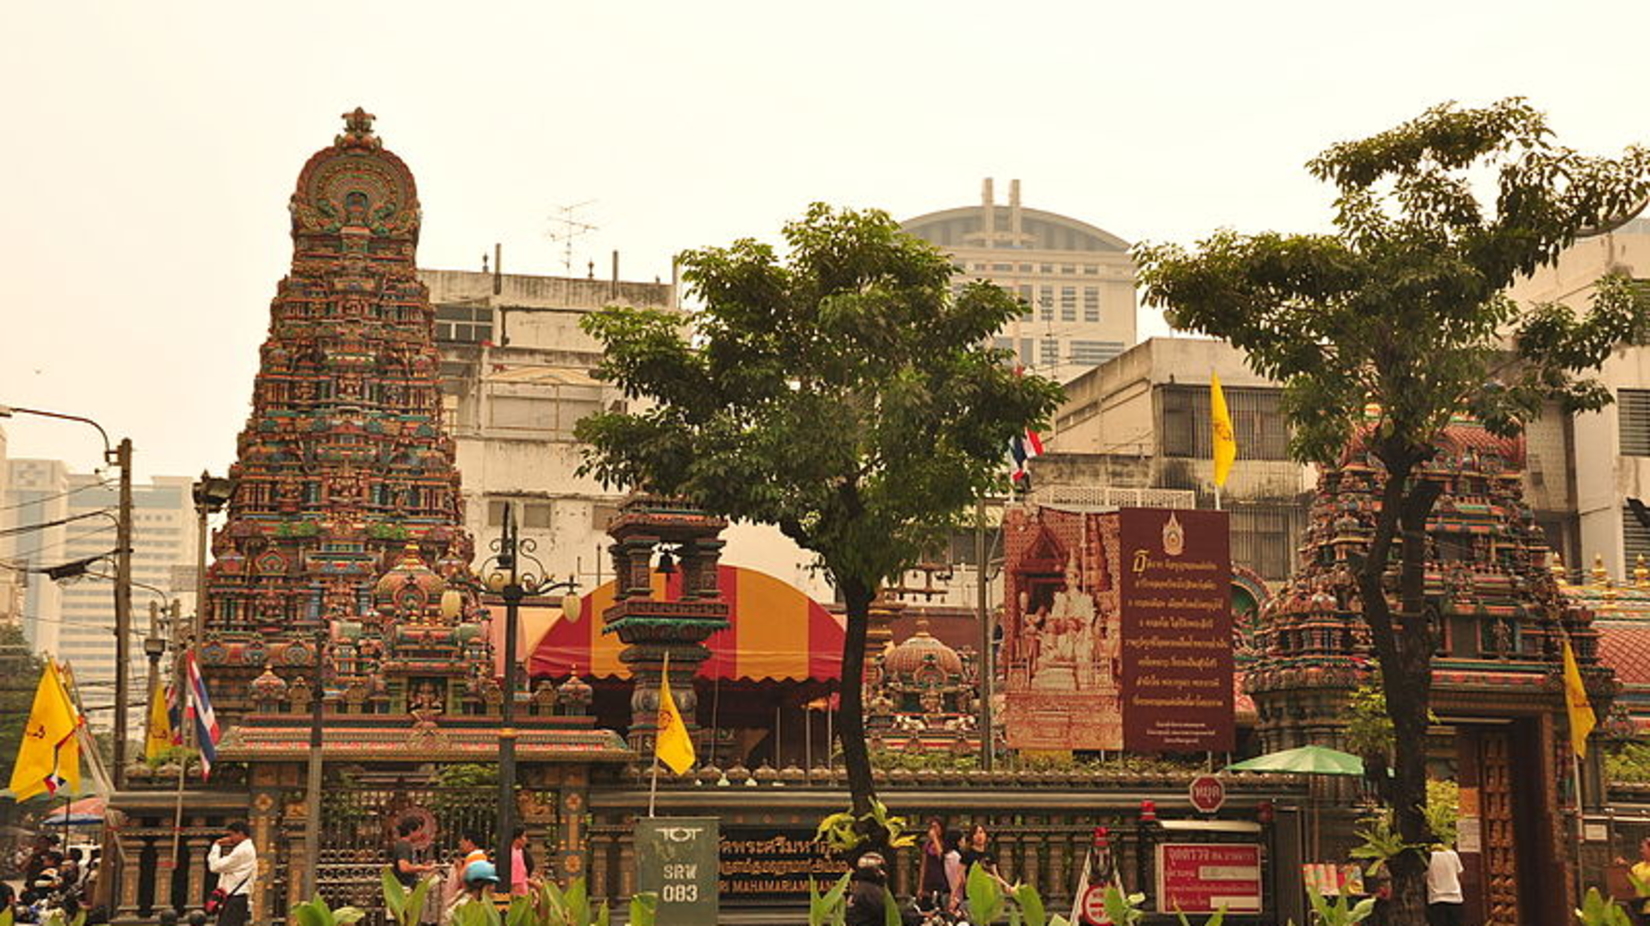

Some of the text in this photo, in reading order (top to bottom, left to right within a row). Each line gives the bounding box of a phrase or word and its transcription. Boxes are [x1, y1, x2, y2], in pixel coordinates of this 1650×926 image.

[655, 827, 704, 842] TOT
[663, 863, 698, 880] SRW
[663, 885, 698, 902] 083
